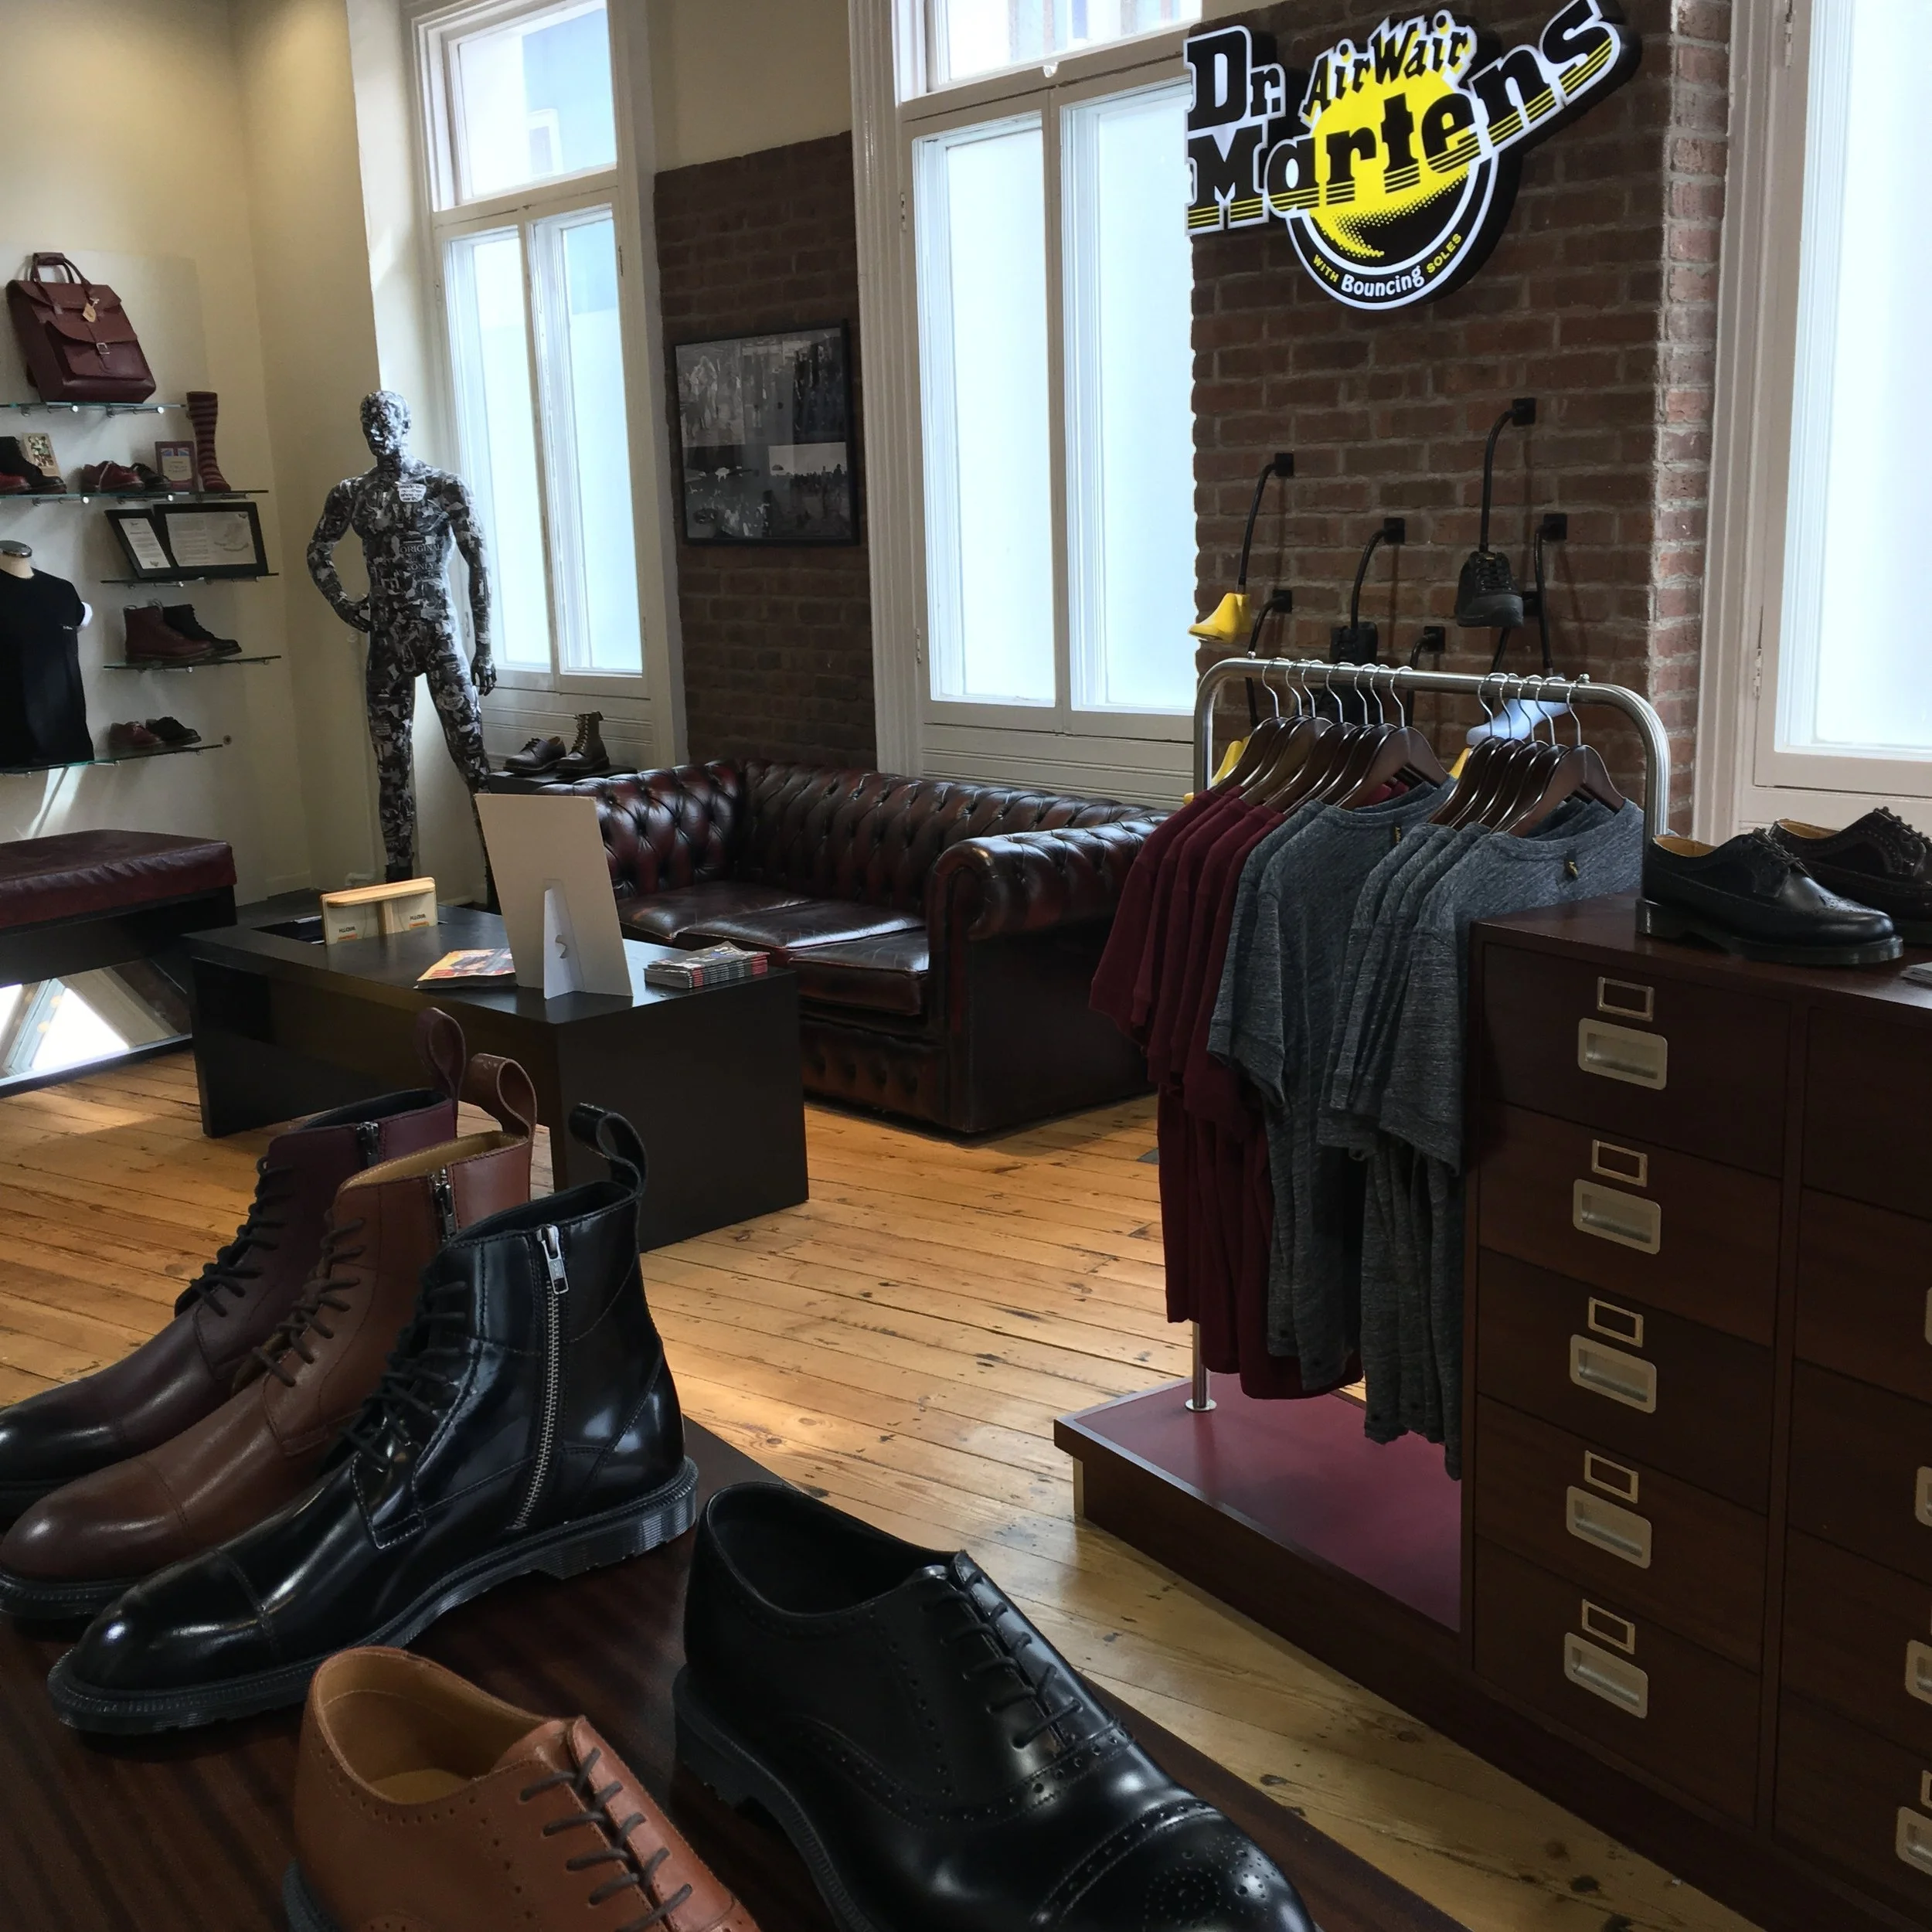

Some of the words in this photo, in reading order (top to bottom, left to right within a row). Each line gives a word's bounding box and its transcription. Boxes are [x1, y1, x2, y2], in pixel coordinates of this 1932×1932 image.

[1185, 27, 1283, 131] Dr.
[1186, 0, 1615, 230] Martens
[1301, 13, 1470, 117] AirWair
[1313, 253, 1339, 283] WITH
[1341, 264, 1425, 297] Bouncing
[1426, 233, 1462, 274] SOLES
